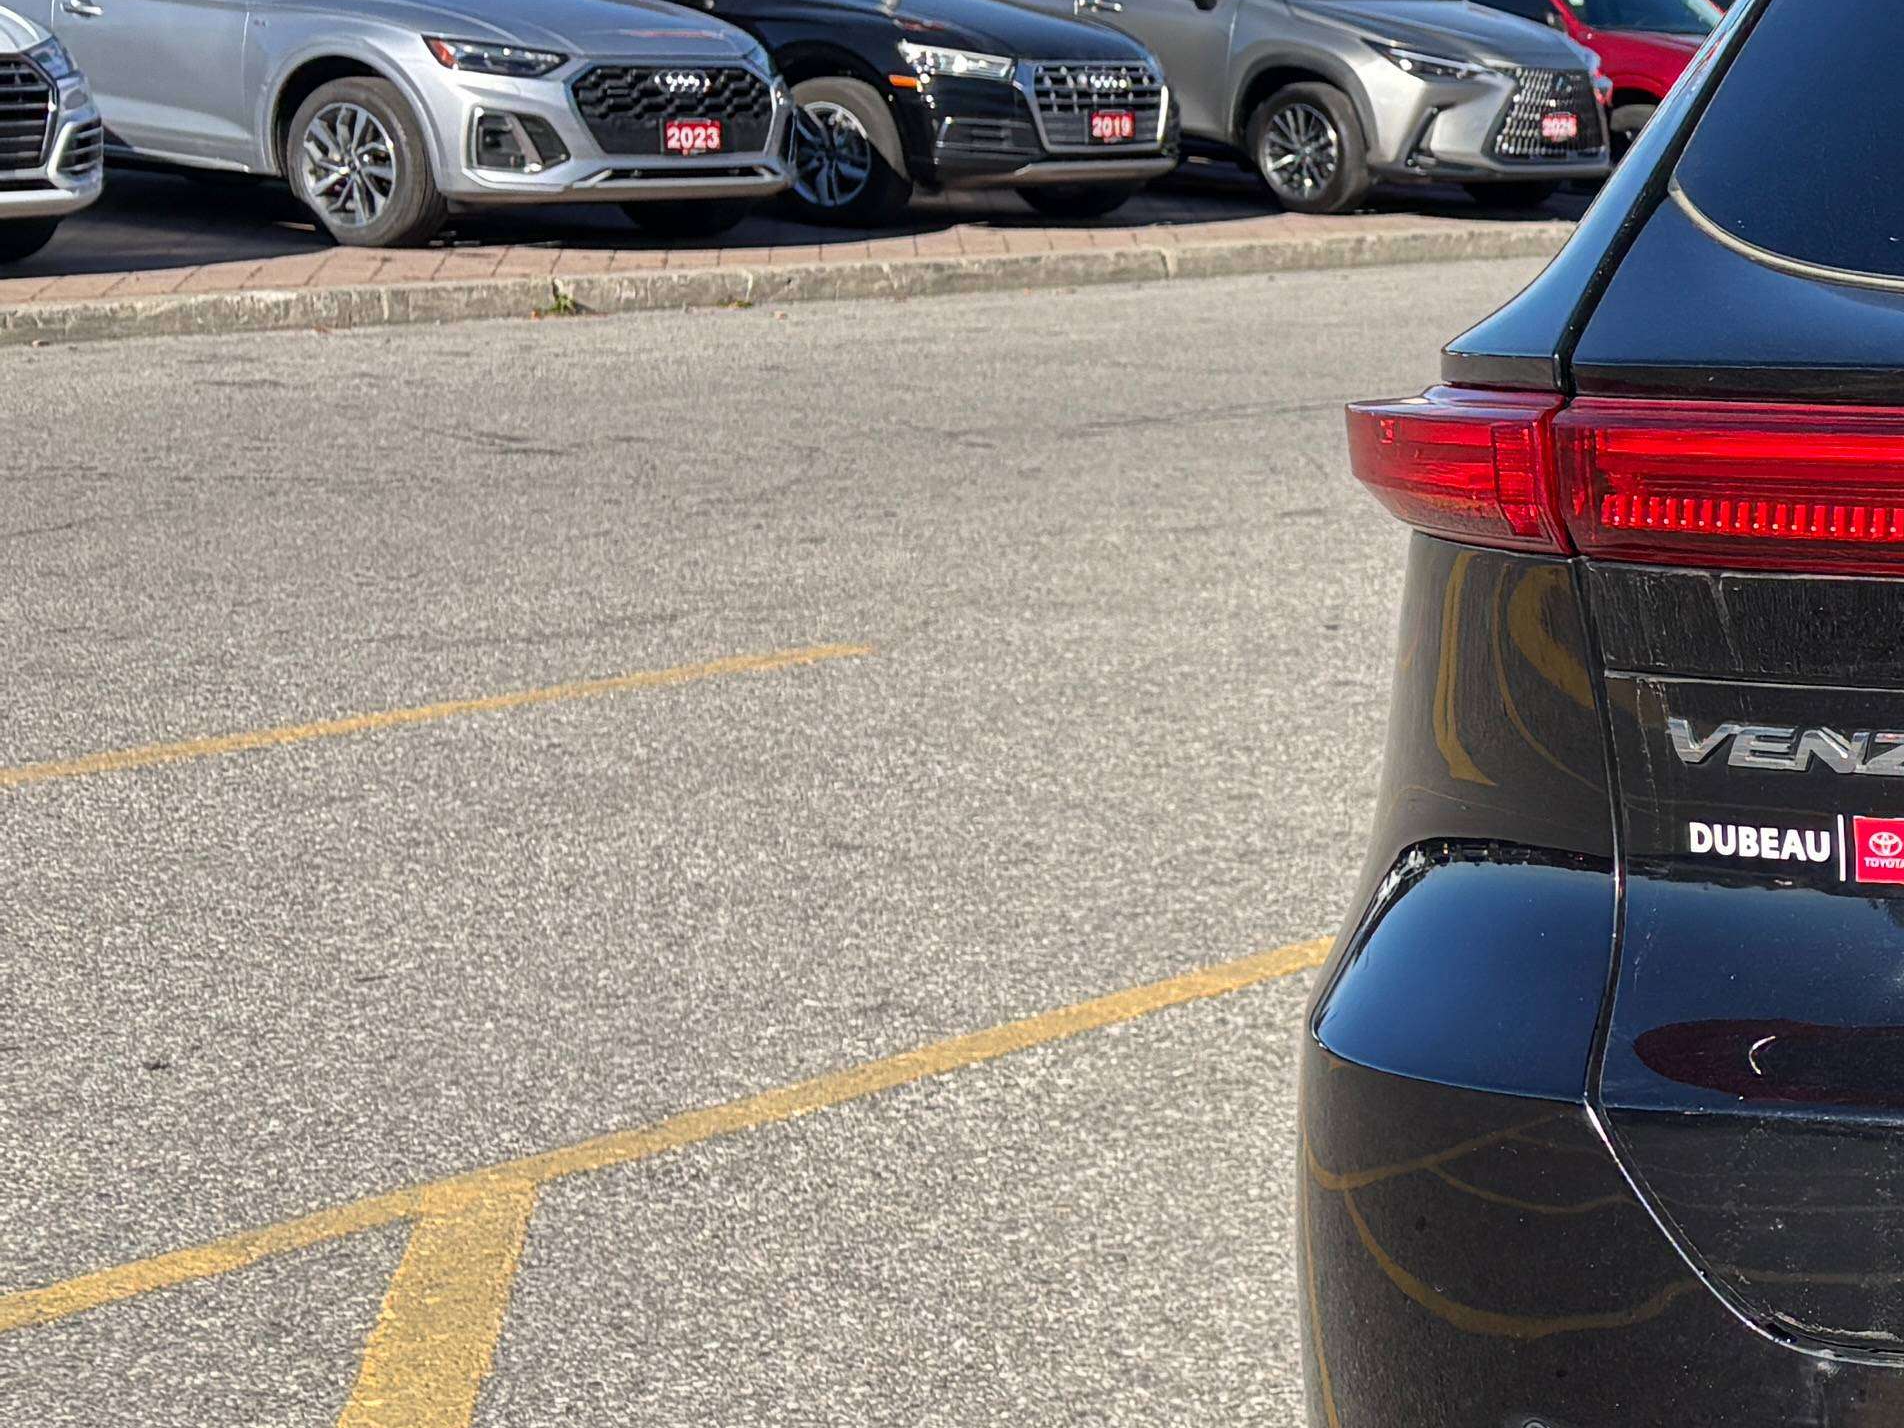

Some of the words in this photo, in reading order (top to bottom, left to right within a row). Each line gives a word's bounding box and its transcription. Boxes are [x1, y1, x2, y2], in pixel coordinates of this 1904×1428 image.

[666, 126, 720, 149] 2023
[1092, 115, 1132, 138] 2019
[1689, 822, 1831, 863] DUBEAU
